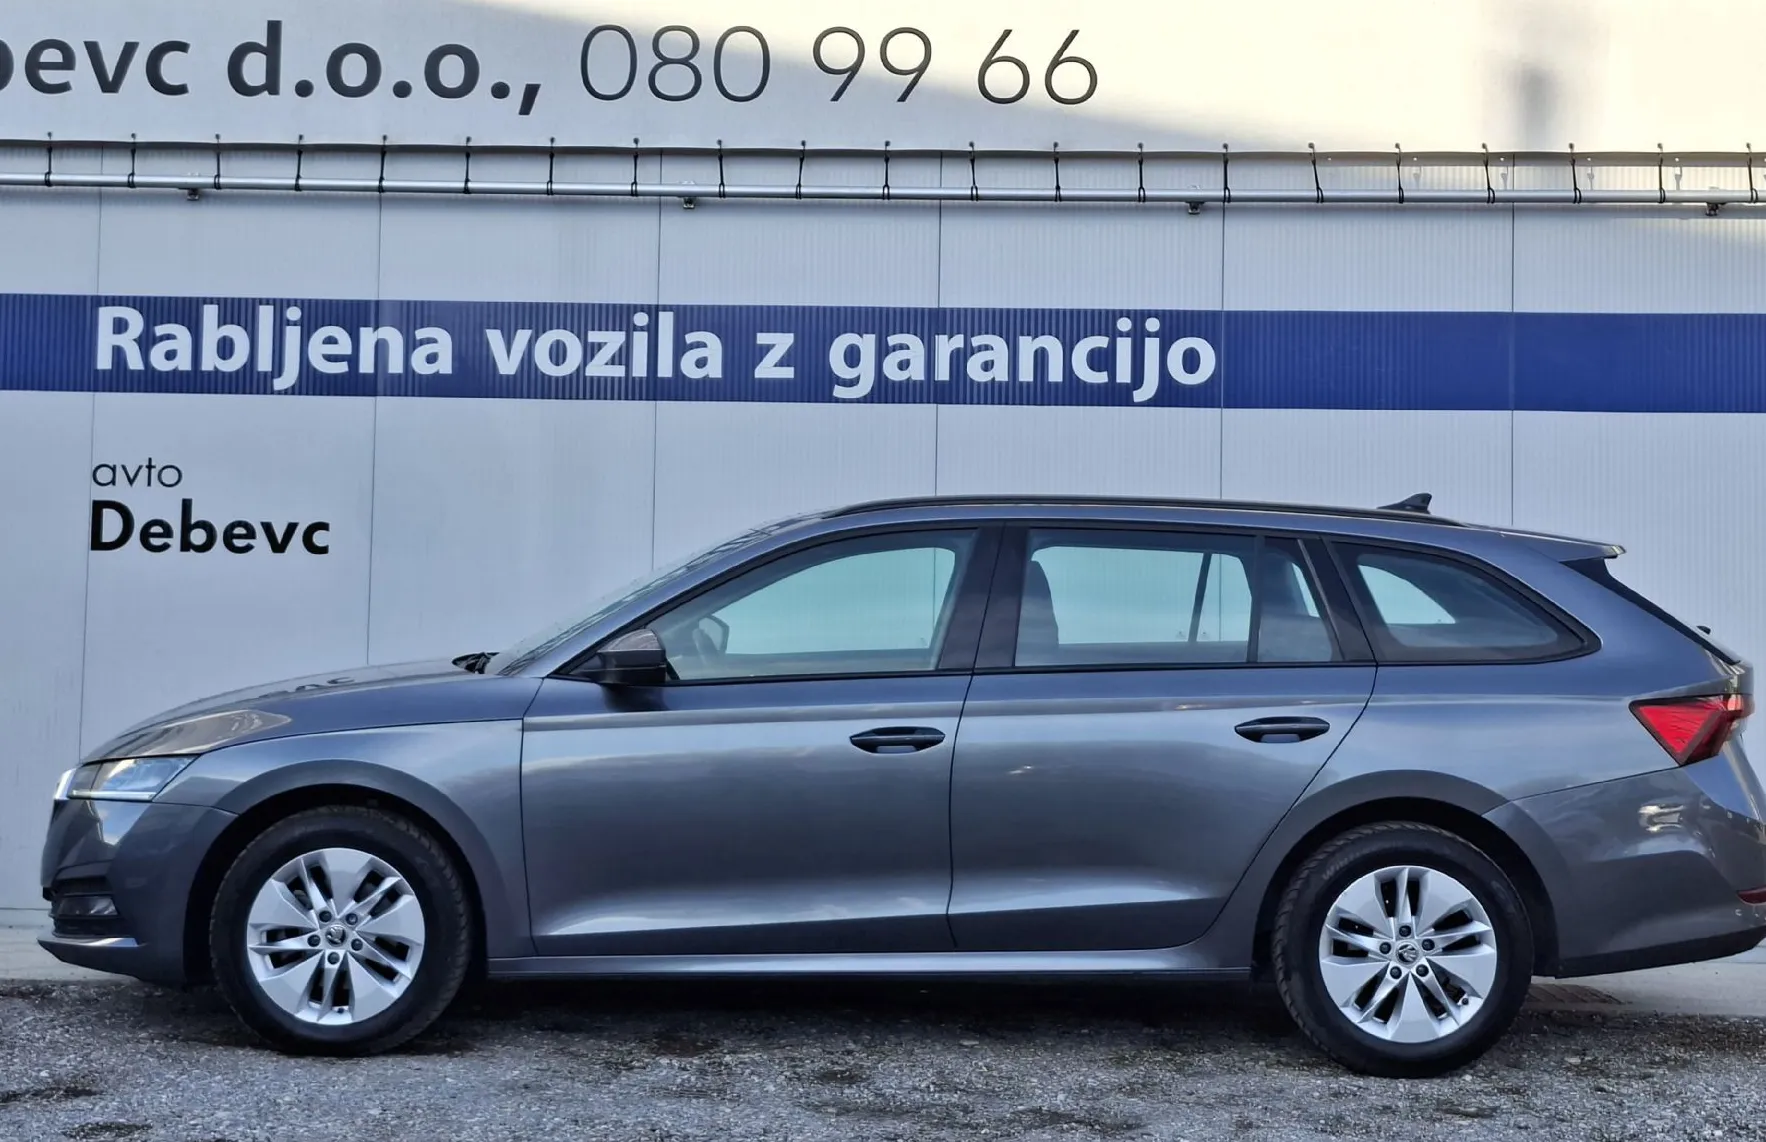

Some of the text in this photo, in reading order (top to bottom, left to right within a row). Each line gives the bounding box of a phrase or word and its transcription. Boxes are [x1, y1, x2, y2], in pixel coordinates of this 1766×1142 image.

[0, 20, 1098, 115] evc d.o.o., 080 99 66
[95, 305, 1216, 402] Rabljena vozila z garancijo
[92, 457, 183, 488] avto
[90, 498, 330, 555] Debevc
